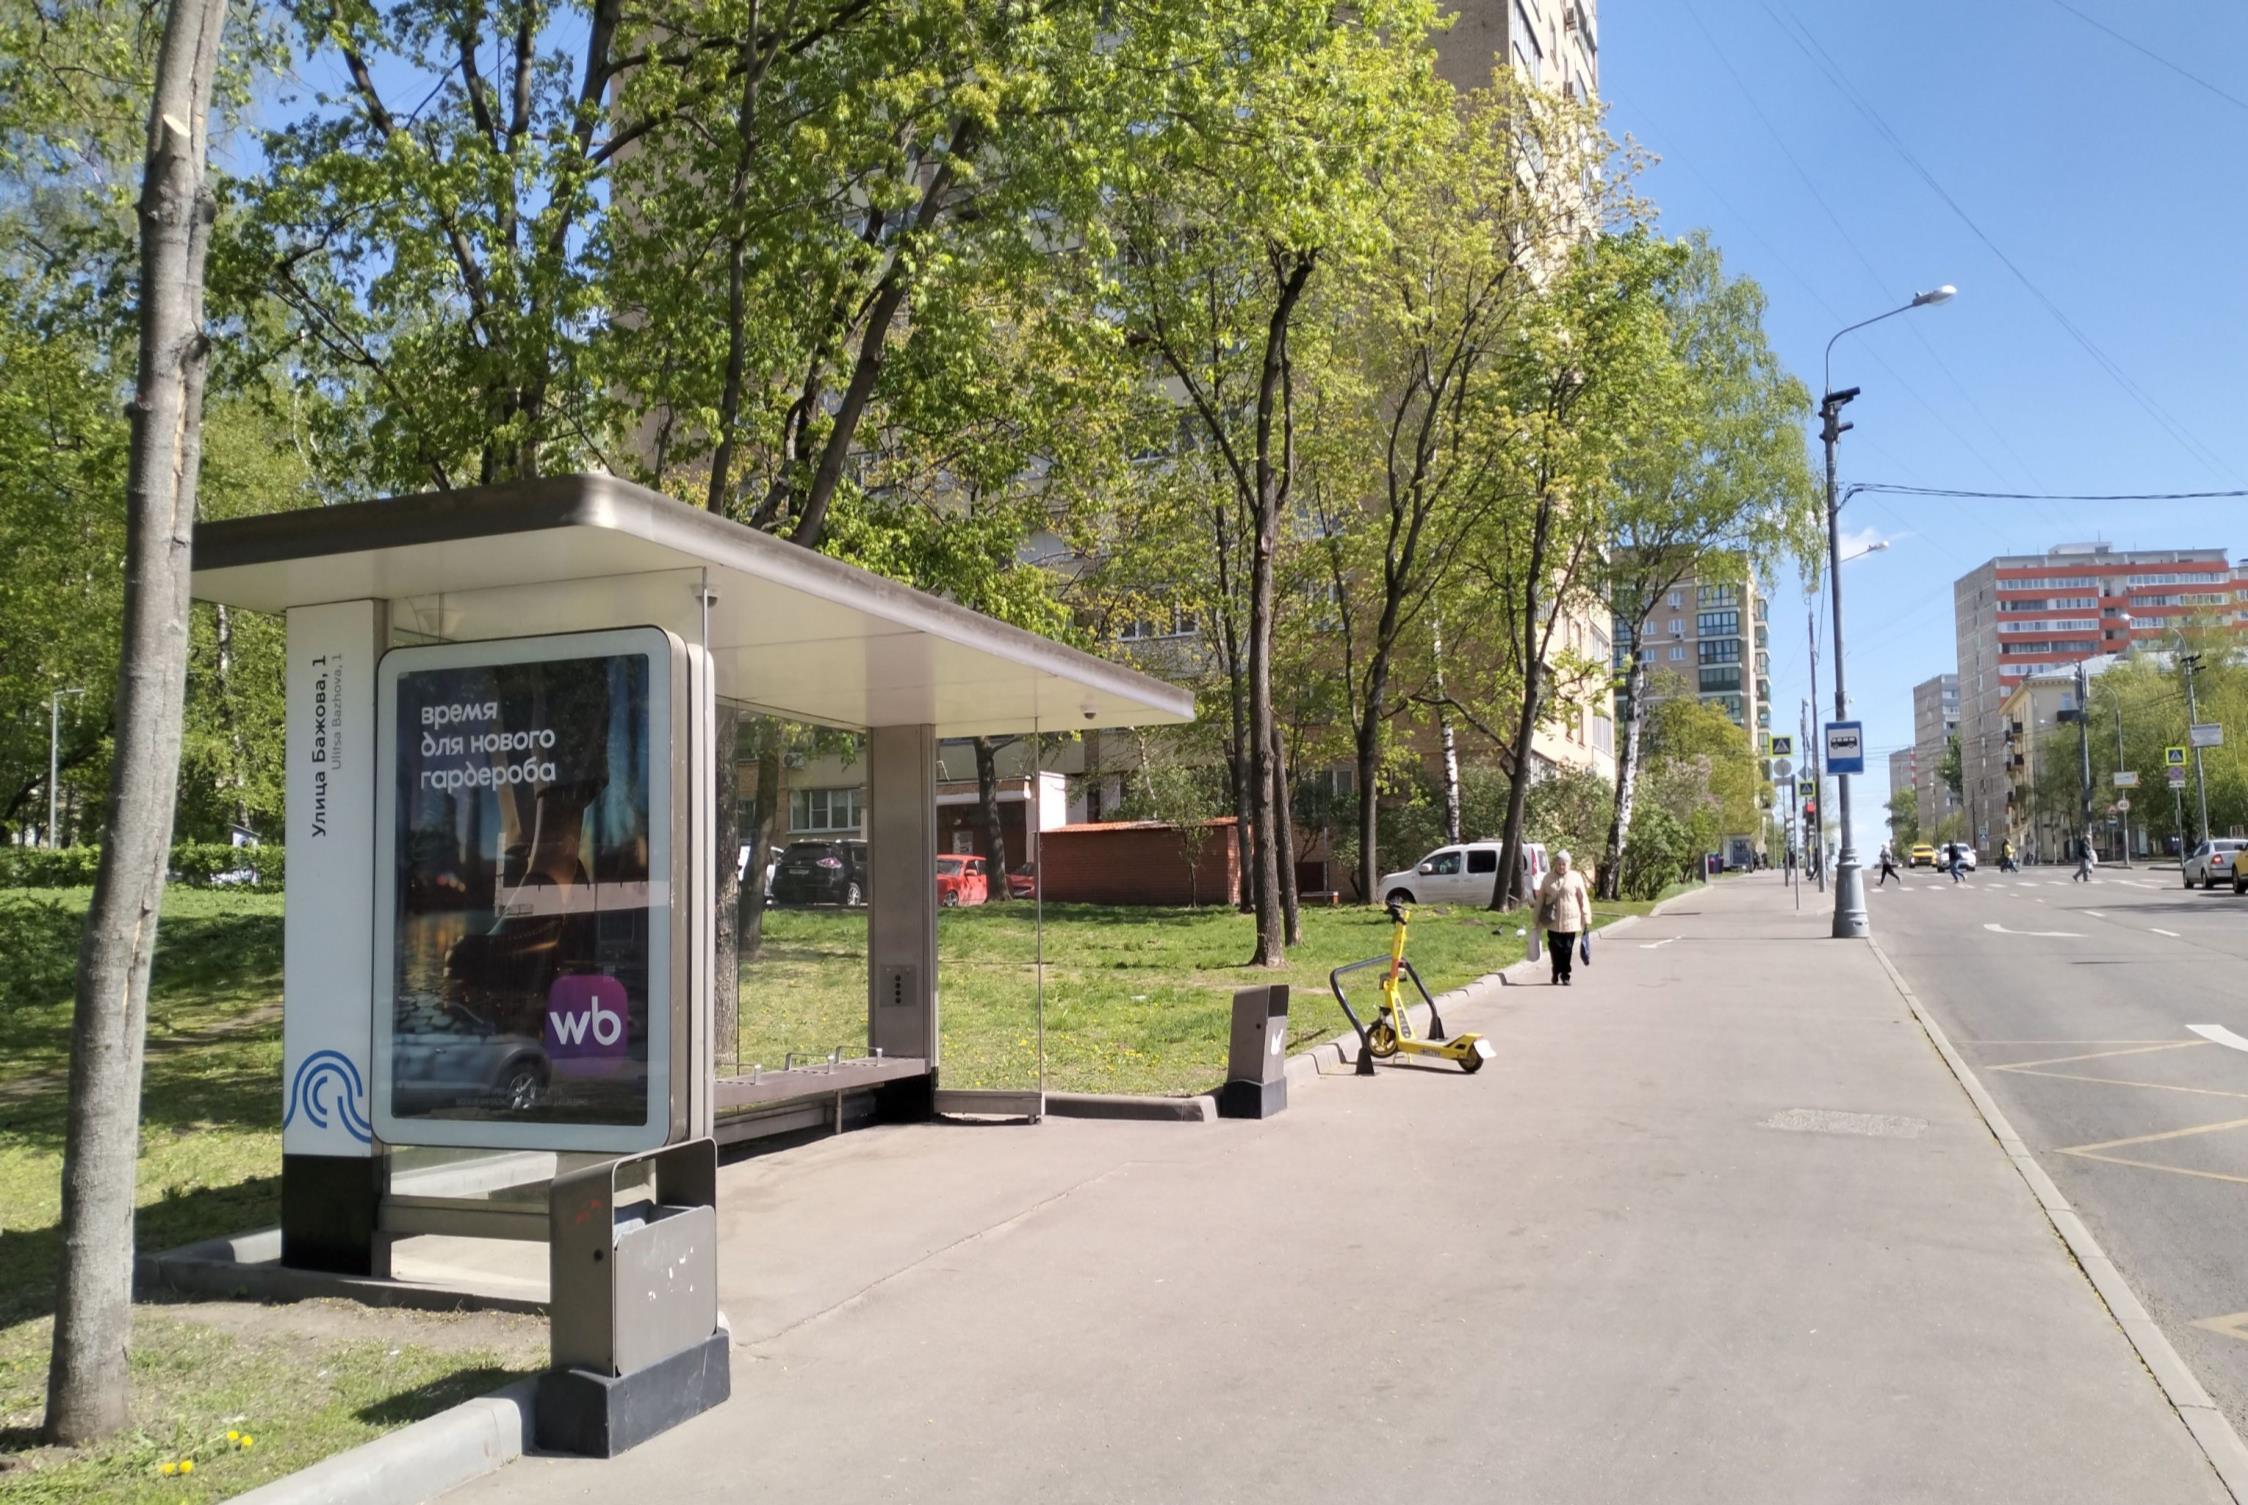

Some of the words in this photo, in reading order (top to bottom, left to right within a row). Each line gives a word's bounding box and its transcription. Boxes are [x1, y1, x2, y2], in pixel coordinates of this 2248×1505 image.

[312, 655, 326, 667] 1
[331, 653, 342, 662] 1
[331, 664, 343, 728] Bazhova,
[311, 673, 328, 763] Бажова,
[421, 701, 498, 731] время
[331, 731, 342, 770] Ulitsa
[421, 731, 464, 757] для
[470, 729, 556, 754] нового
[420, 756, 557, 794] гардероба
[311, 771, 328, 837] Улица
[549, 995, 622, 1046] wb
